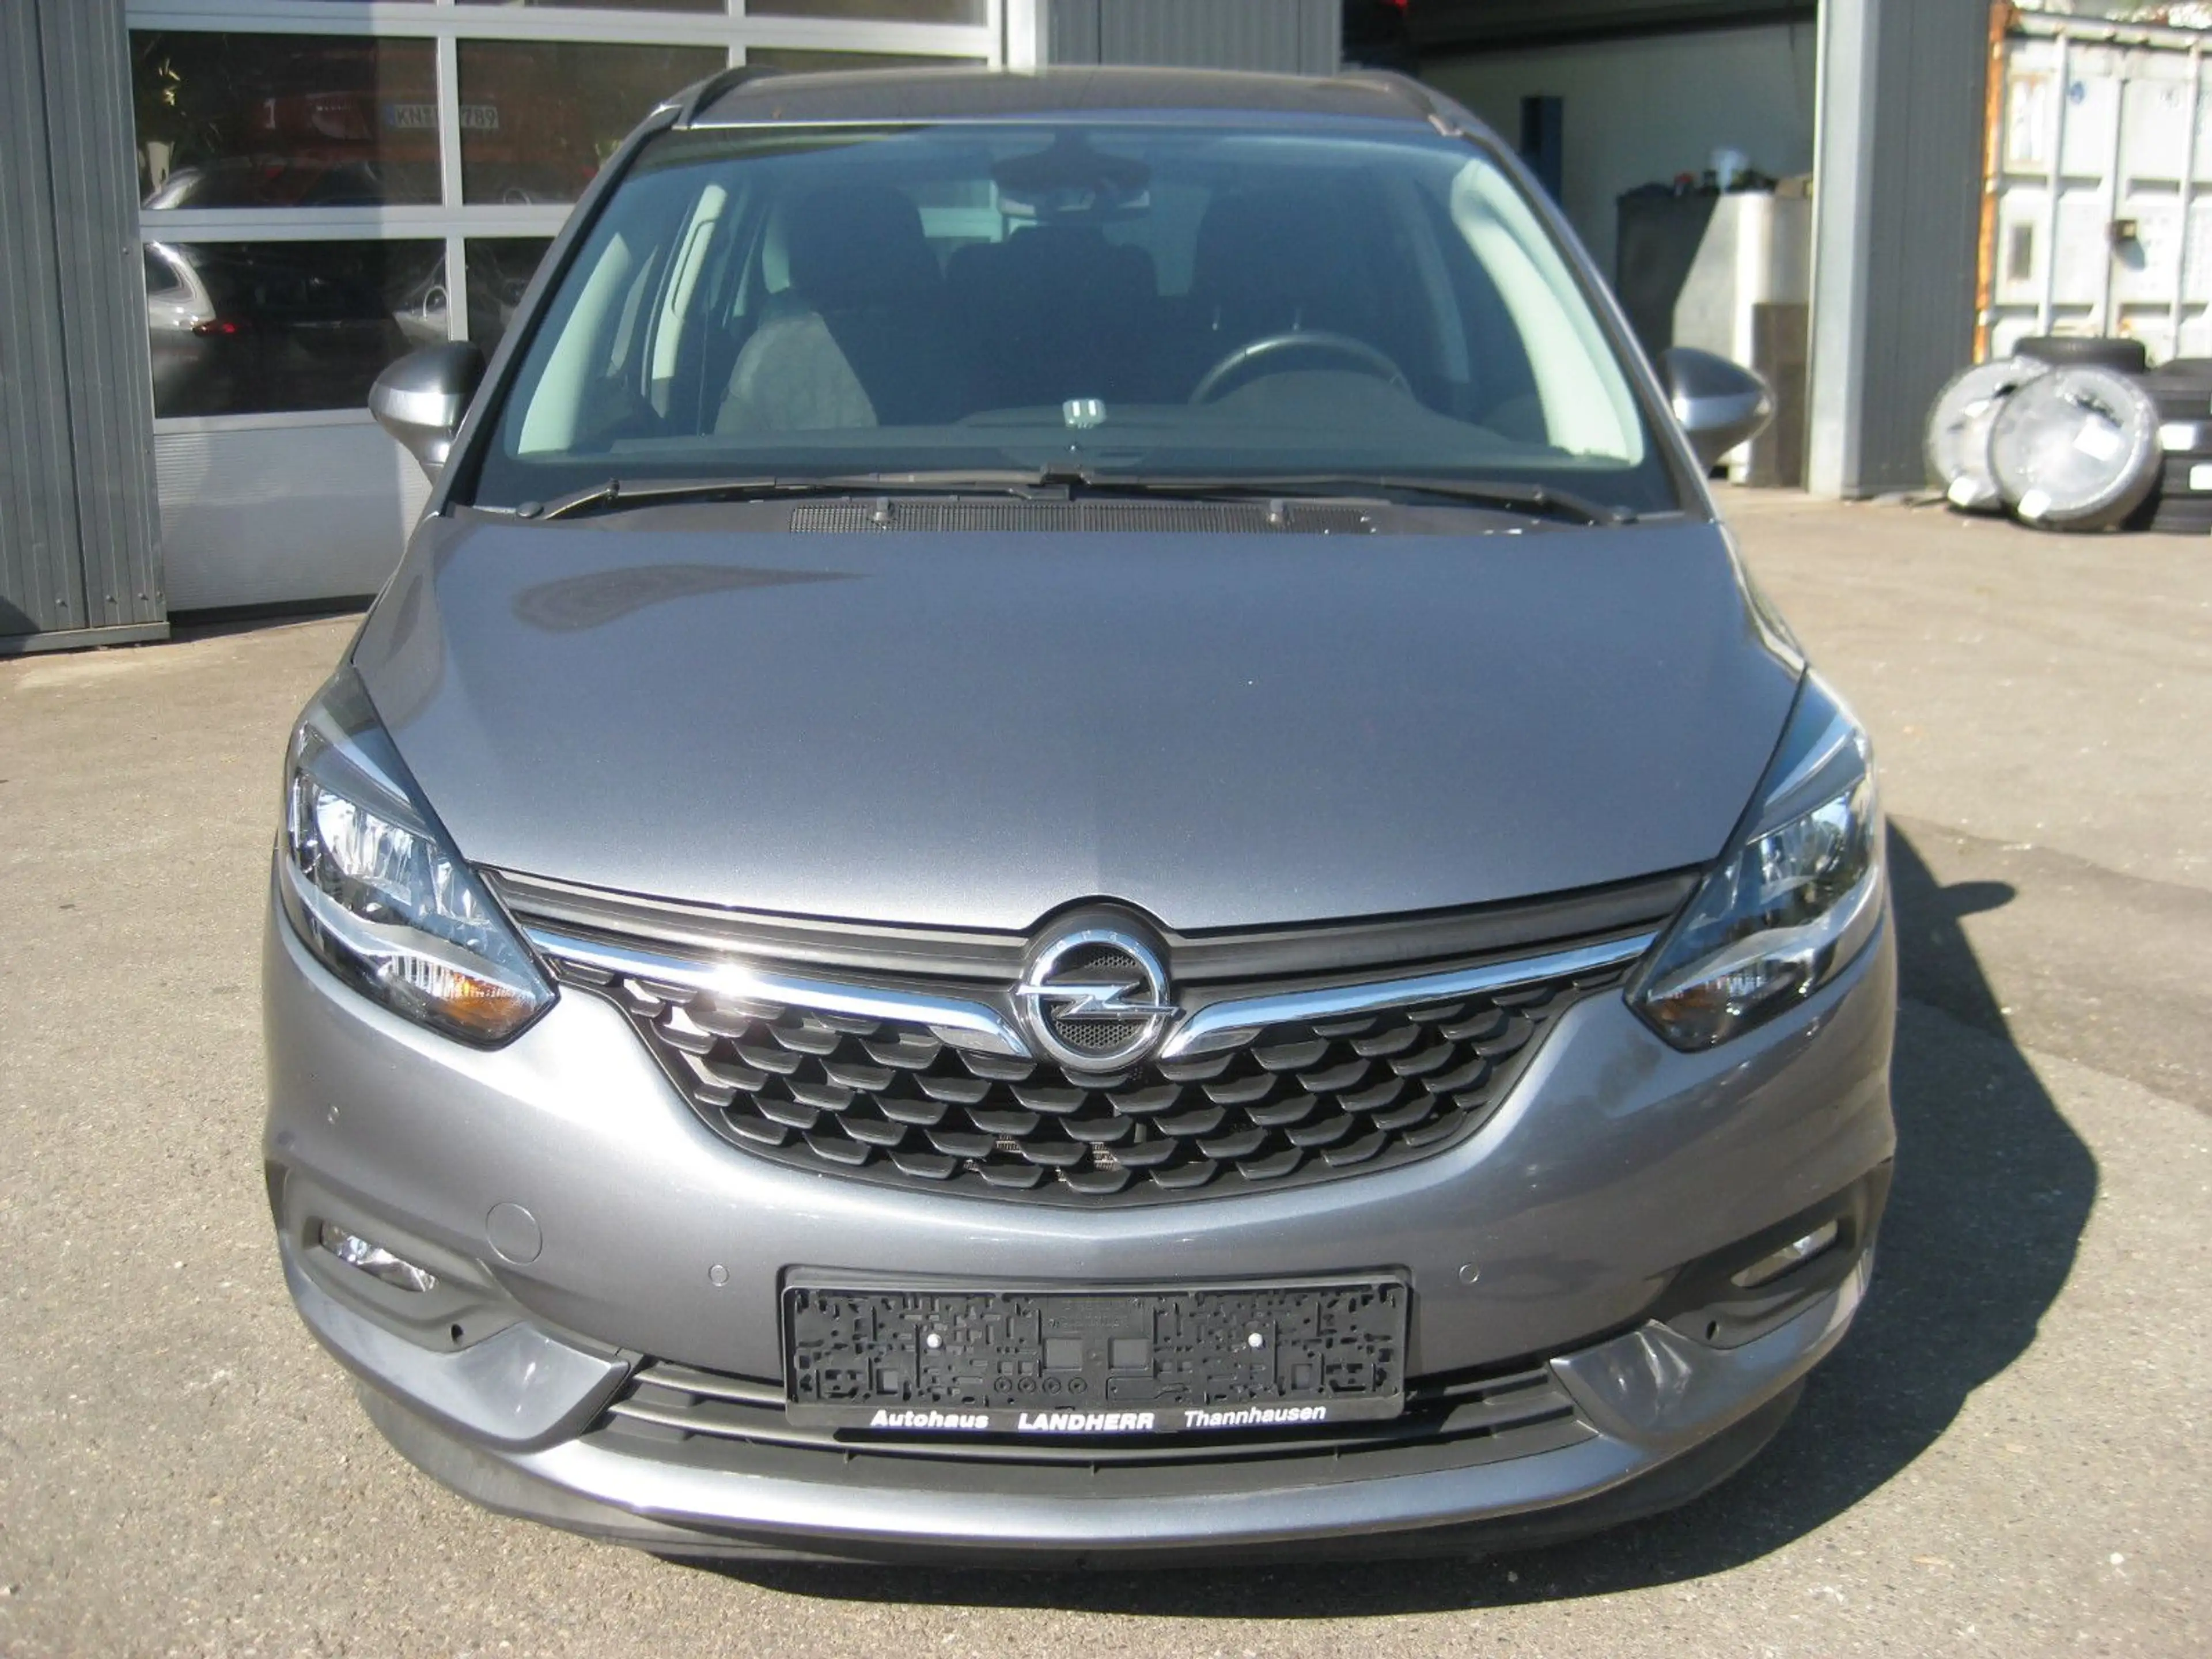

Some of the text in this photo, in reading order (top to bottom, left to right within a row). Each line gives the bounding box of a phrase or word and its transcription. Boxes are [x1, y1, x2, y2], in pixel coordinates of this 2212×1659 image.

[870, 1406, 1327, 1431] Autohaus LANDHERR Thannhausen
